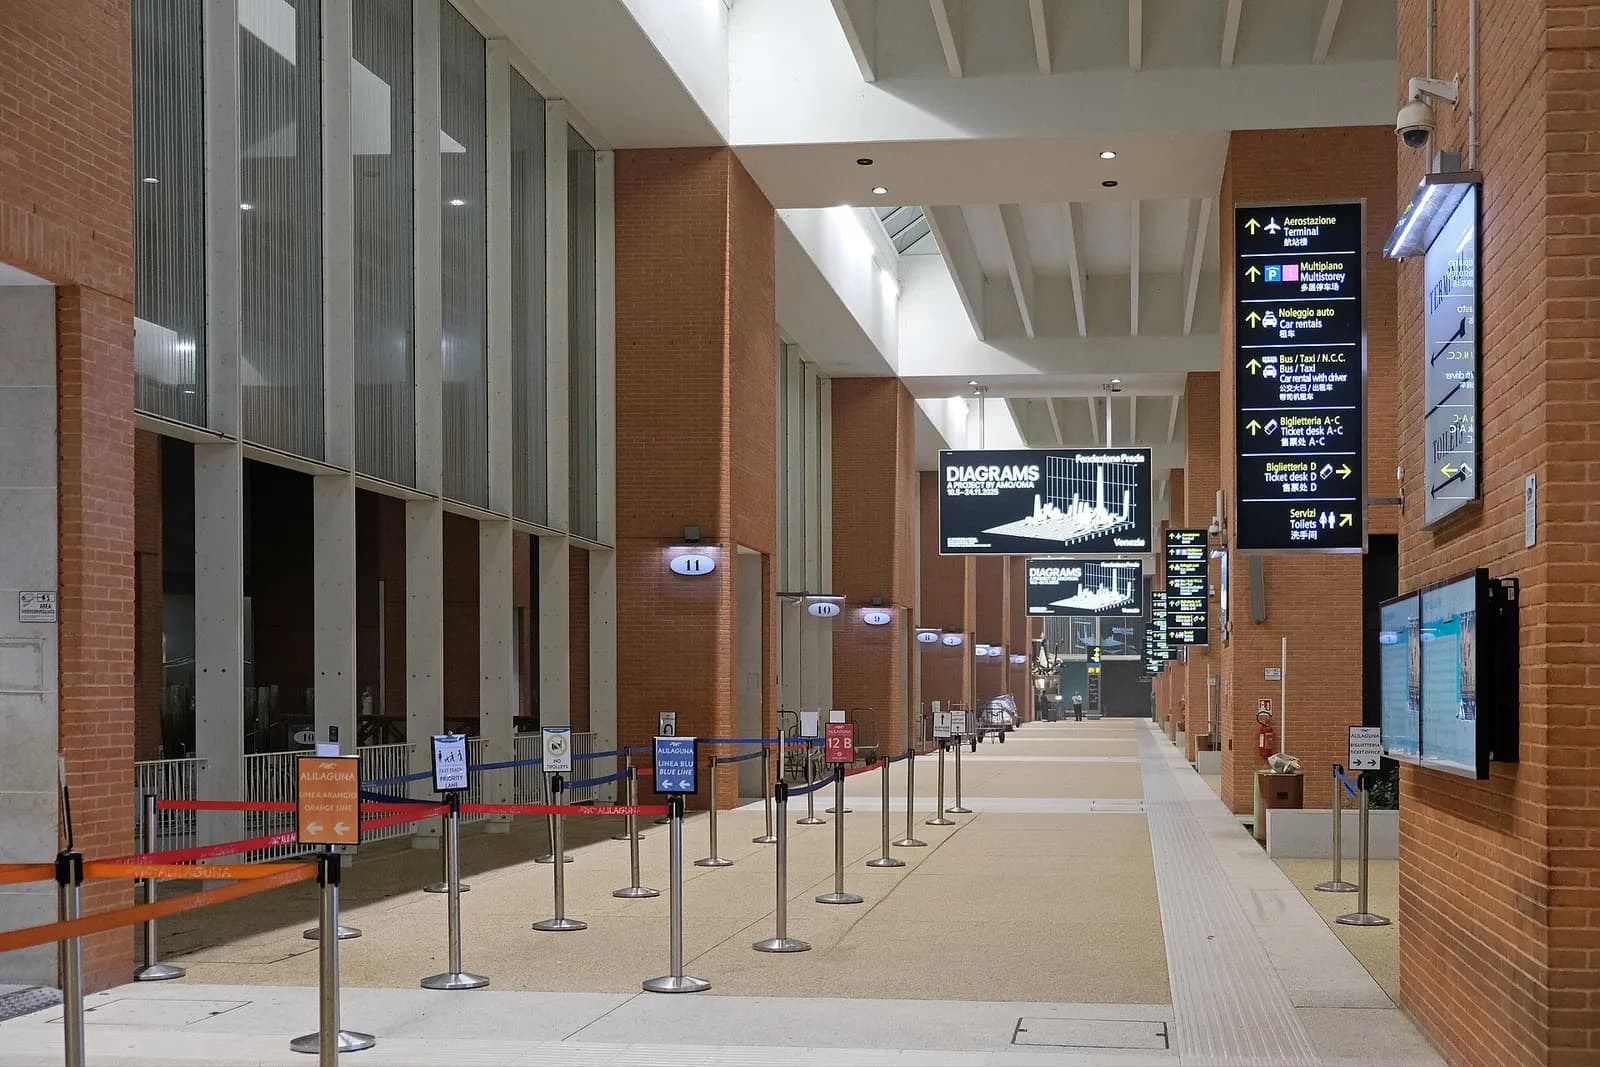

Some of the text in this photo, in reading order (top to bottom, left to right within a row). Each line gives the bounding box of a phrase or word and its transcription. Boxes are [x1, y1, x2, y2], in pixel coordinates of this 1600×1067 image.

[1284, 216, 1336, 226] Aerostazione
[1284, 226, 1319, 236] Terminal
[1300, 262, 1344, 272] Multipiano
[1300, 272, 1346, 283] Multistorey
[1279, 308, 1334, 319] Noleggio auto
[1280, 318, 1322, 328] Car rentals
[1280, 354, 1294, 364] Bus
[1300, 354, 1316, 363] Taxi
[1322, 354, 1346, 363] N.C.C.
[1280, 364, 1294, 373] Bus
[1300, 364, 1316, 373] Taxi
[1280, 373, 1347, 383] Car rental with driver
[1280, 416, 1321, 427] Biglietteria
[1281, 427, 1304, 436] Ticket
[1306, 426, 1324, 435] desk
[1121, 454, 1145, 463] Prada
[1266, 462, 1317, 472] Biglietteria D
[946, 465, 1040, 482] DIAGRAMS
[1264, 472, 1317, 482] Ticket desk D
[1310, 483, 1317, 492] D
[1290, 508, 1316, 518] Servizi
[1290, 519, 1317, 529] Toilets
[1290, 530, 1317, 540] 洗手间
[1113, 538, 1146, 547] Venezia
[685, 560, 699, 571] 11
[1029, 568, 1082, 577] DIAGRAMS
[817, 606, 831, 614] 10
[828, 737, 851, 749] 12 B
[300, 772, 355, 781] ALILAGUNA
